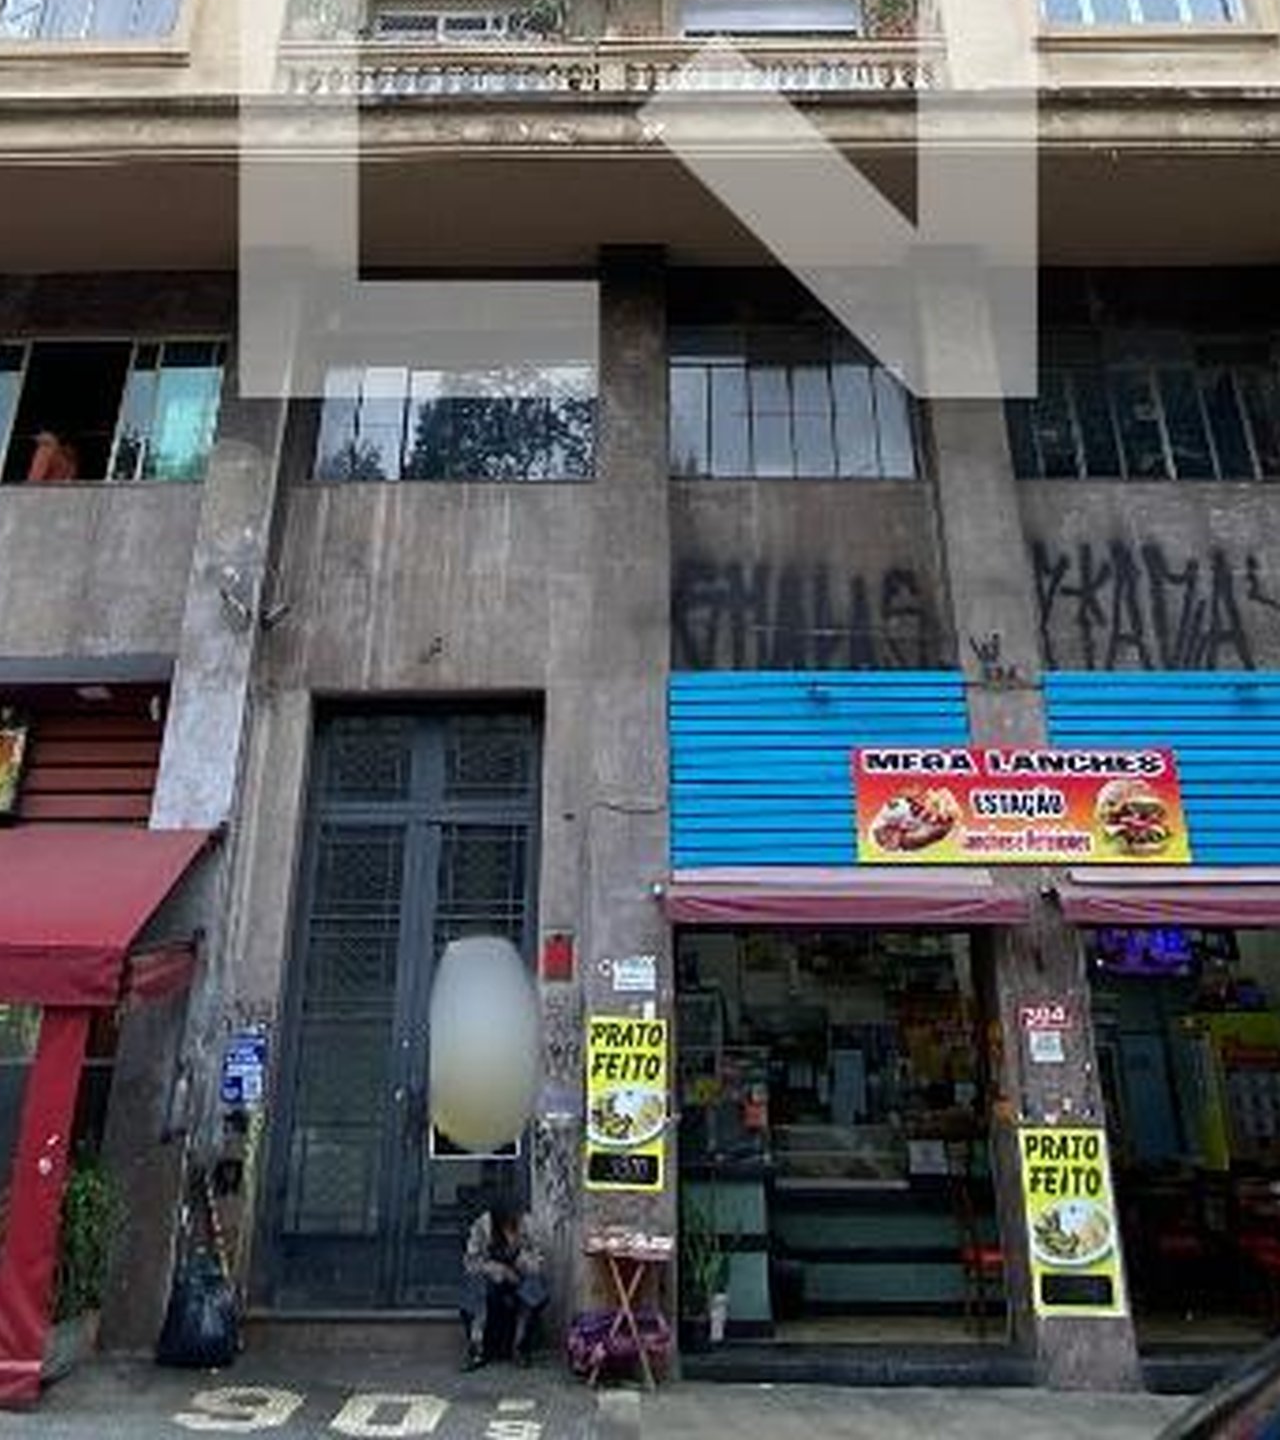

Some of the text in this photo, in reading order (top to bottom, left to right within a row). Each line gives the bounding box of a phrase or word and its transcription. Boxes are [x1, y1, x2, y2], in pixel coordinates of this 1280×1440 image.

[863, 750, 1166, 775] MEGA LANCHES
[972, 786, 1065, 818] ESTAÇÃO
[590, 1022, 663, 1048] PRATO
[591, 1053, 661, 1081] FEITO
[1025, 1134, 1100, 1161] PRATO
[1029, 1165, 1102, 1196] FEITO
